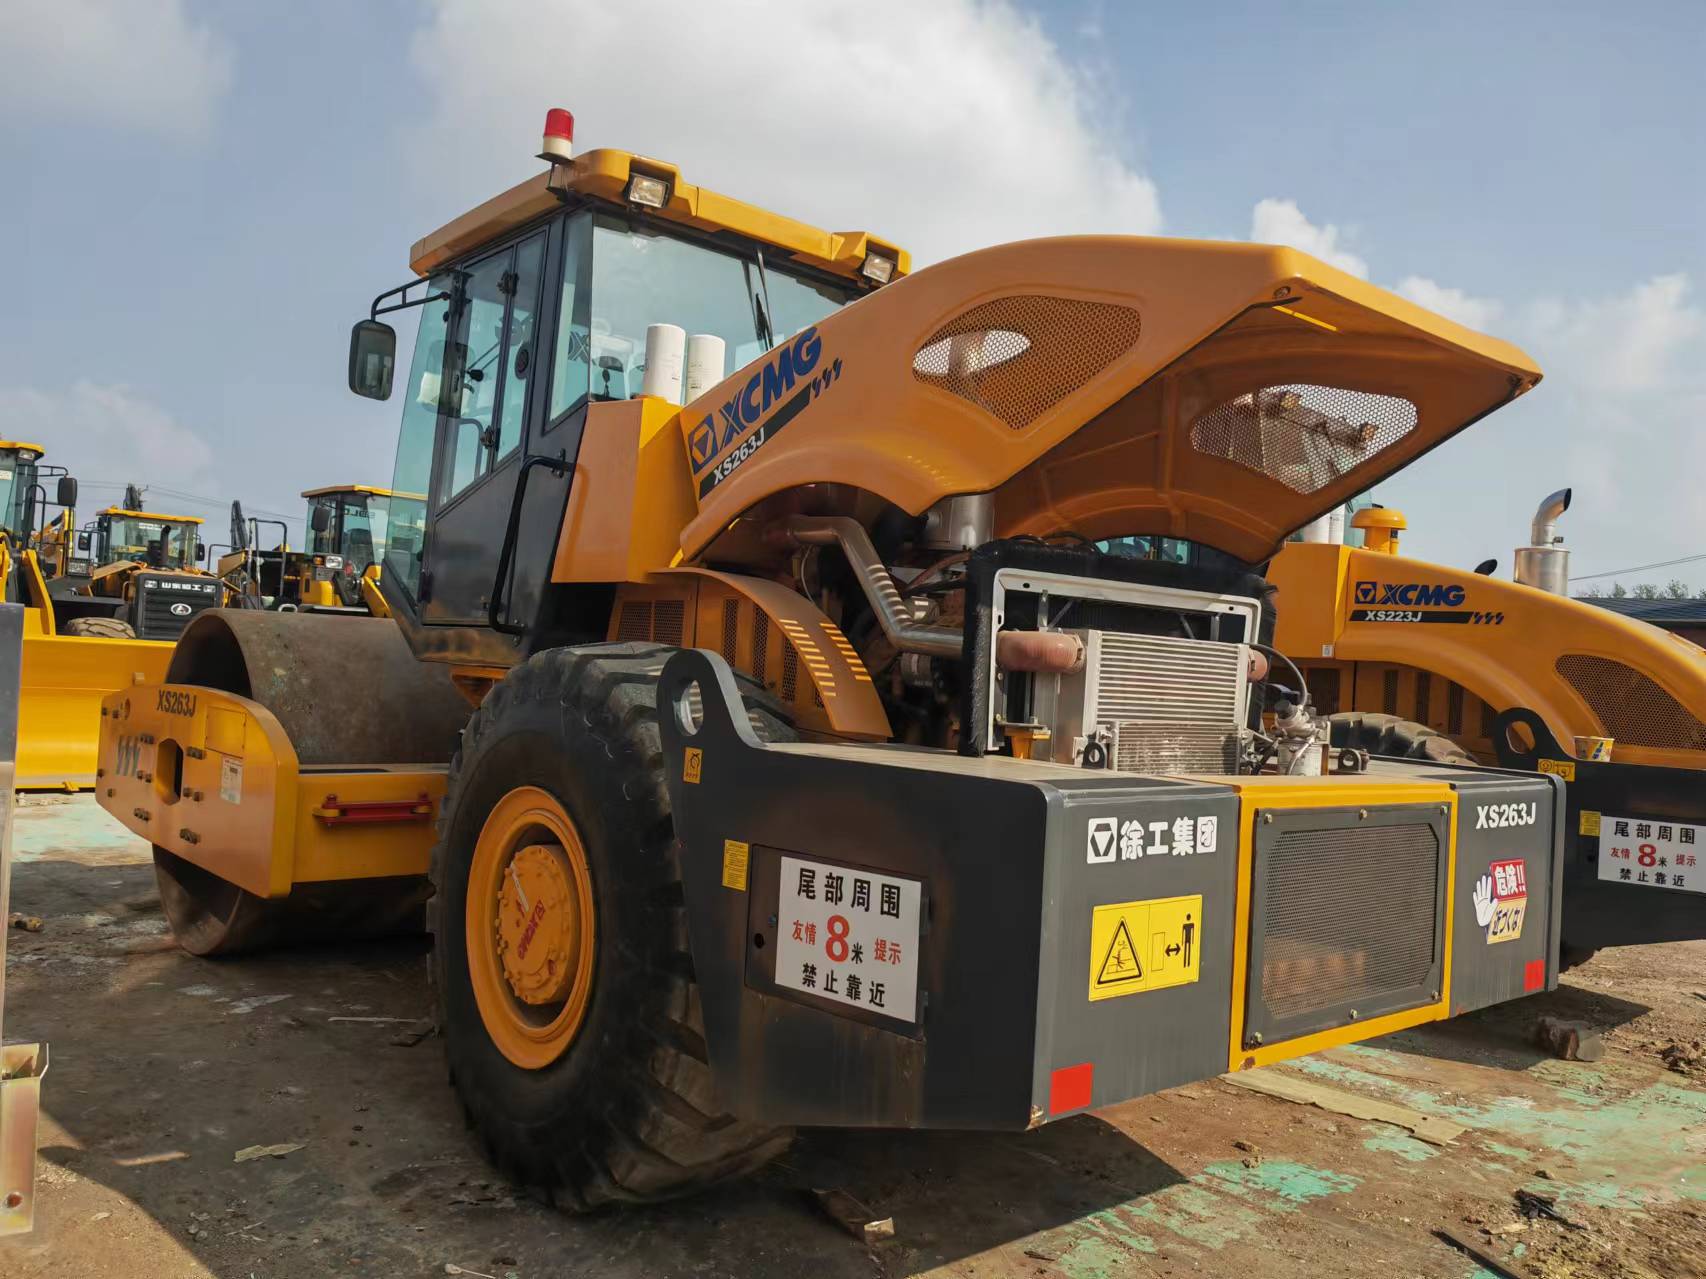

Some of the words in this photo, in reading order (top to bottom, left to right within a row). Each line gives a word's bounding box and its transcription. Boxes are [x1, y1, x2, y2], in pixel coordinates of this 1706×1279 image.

[719, 326, 822, 451] XCMG
[713, 427, 765, 485] XS263J
[1377, 584, 1465, 607] XCMG
[1365, 610, 1422, 622] XS223J
[157, 689, 197, 718] XS263J
[1476, 802, 1536, 829] XS263J
[1119, 816, 1218, 861] 徐工集团
[1614, 821, 1695, 845] 尾部周围
[1675, 853, 1697, 869] 提示
[1619, 868, 1685, 887] 禁止靠近
[797, 867, 901, 918] 尾部周围
[792, 919, 817, 945] 友情
[874, 938, 902, 965] 提示
[802, 962, 886, 1008] 禁止靠近
